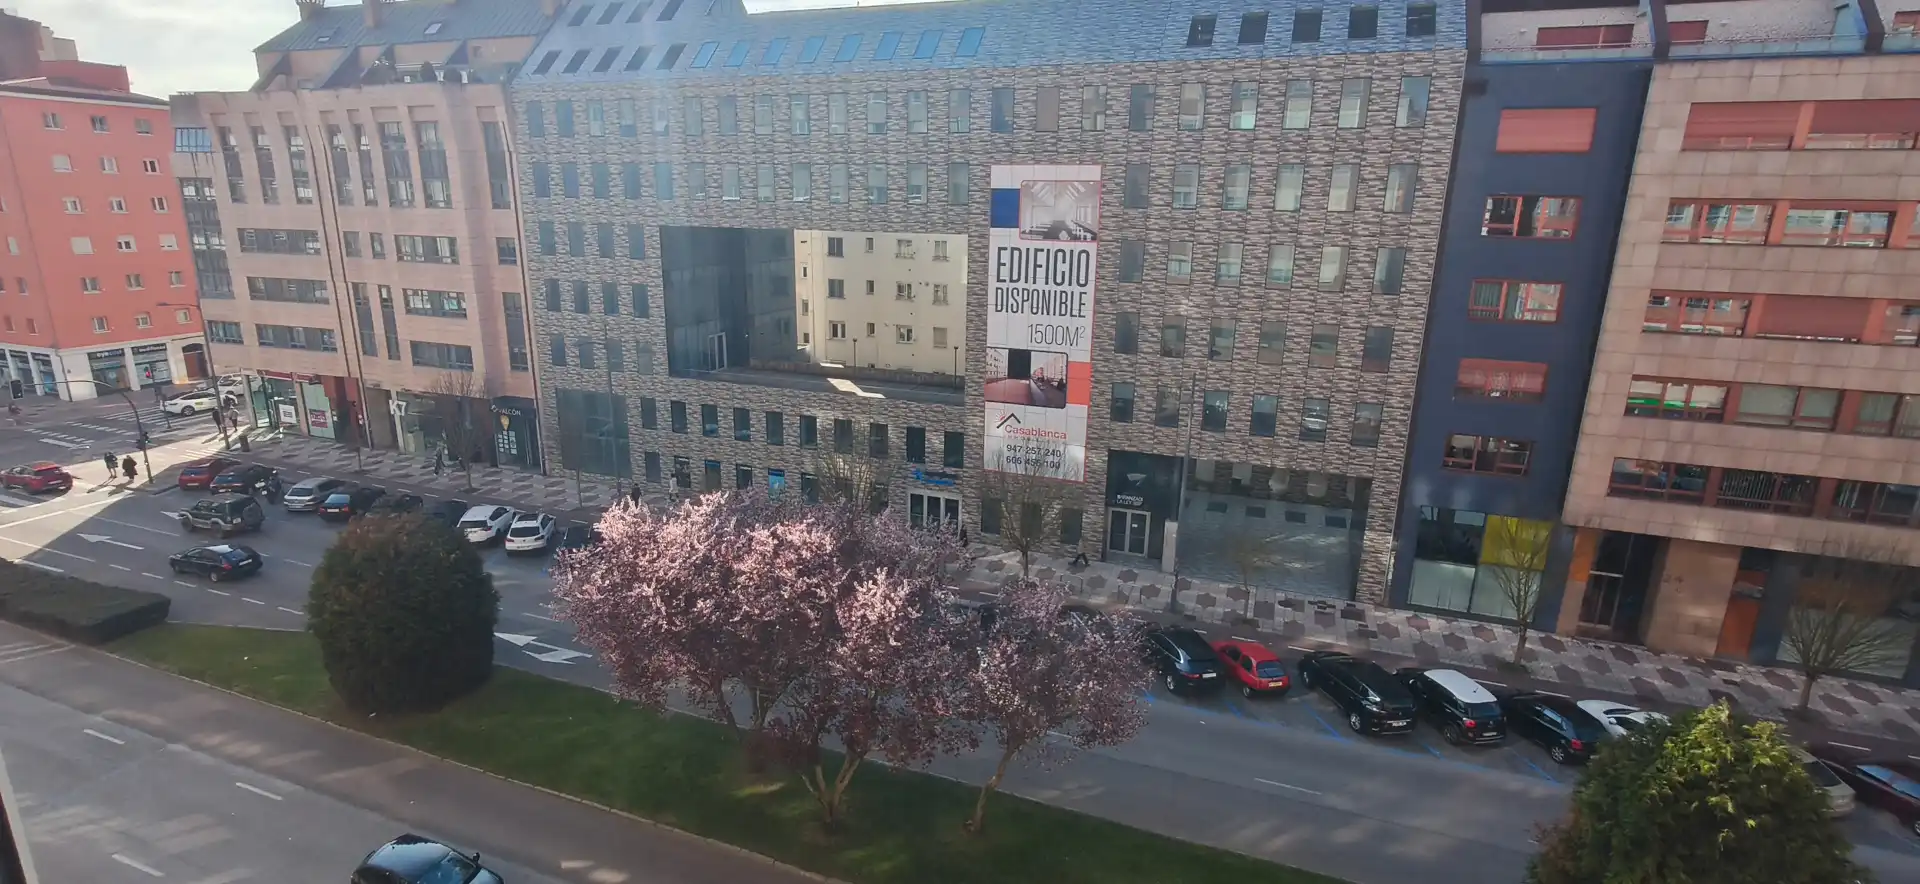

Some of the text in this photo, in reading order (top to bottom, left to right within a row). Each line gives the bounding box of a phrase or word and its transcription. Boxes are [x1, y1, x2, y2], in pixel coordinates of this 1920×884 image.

[996, 246, 1090, 287] EDIFICIO
[995, 287, 1087, 318] DISPONIBLE
[1005, 424, 1067, 439] Casablanca
[1007, 444, 1061, 457] 947 257 240
[1006, 456, 1022, 464] 606
